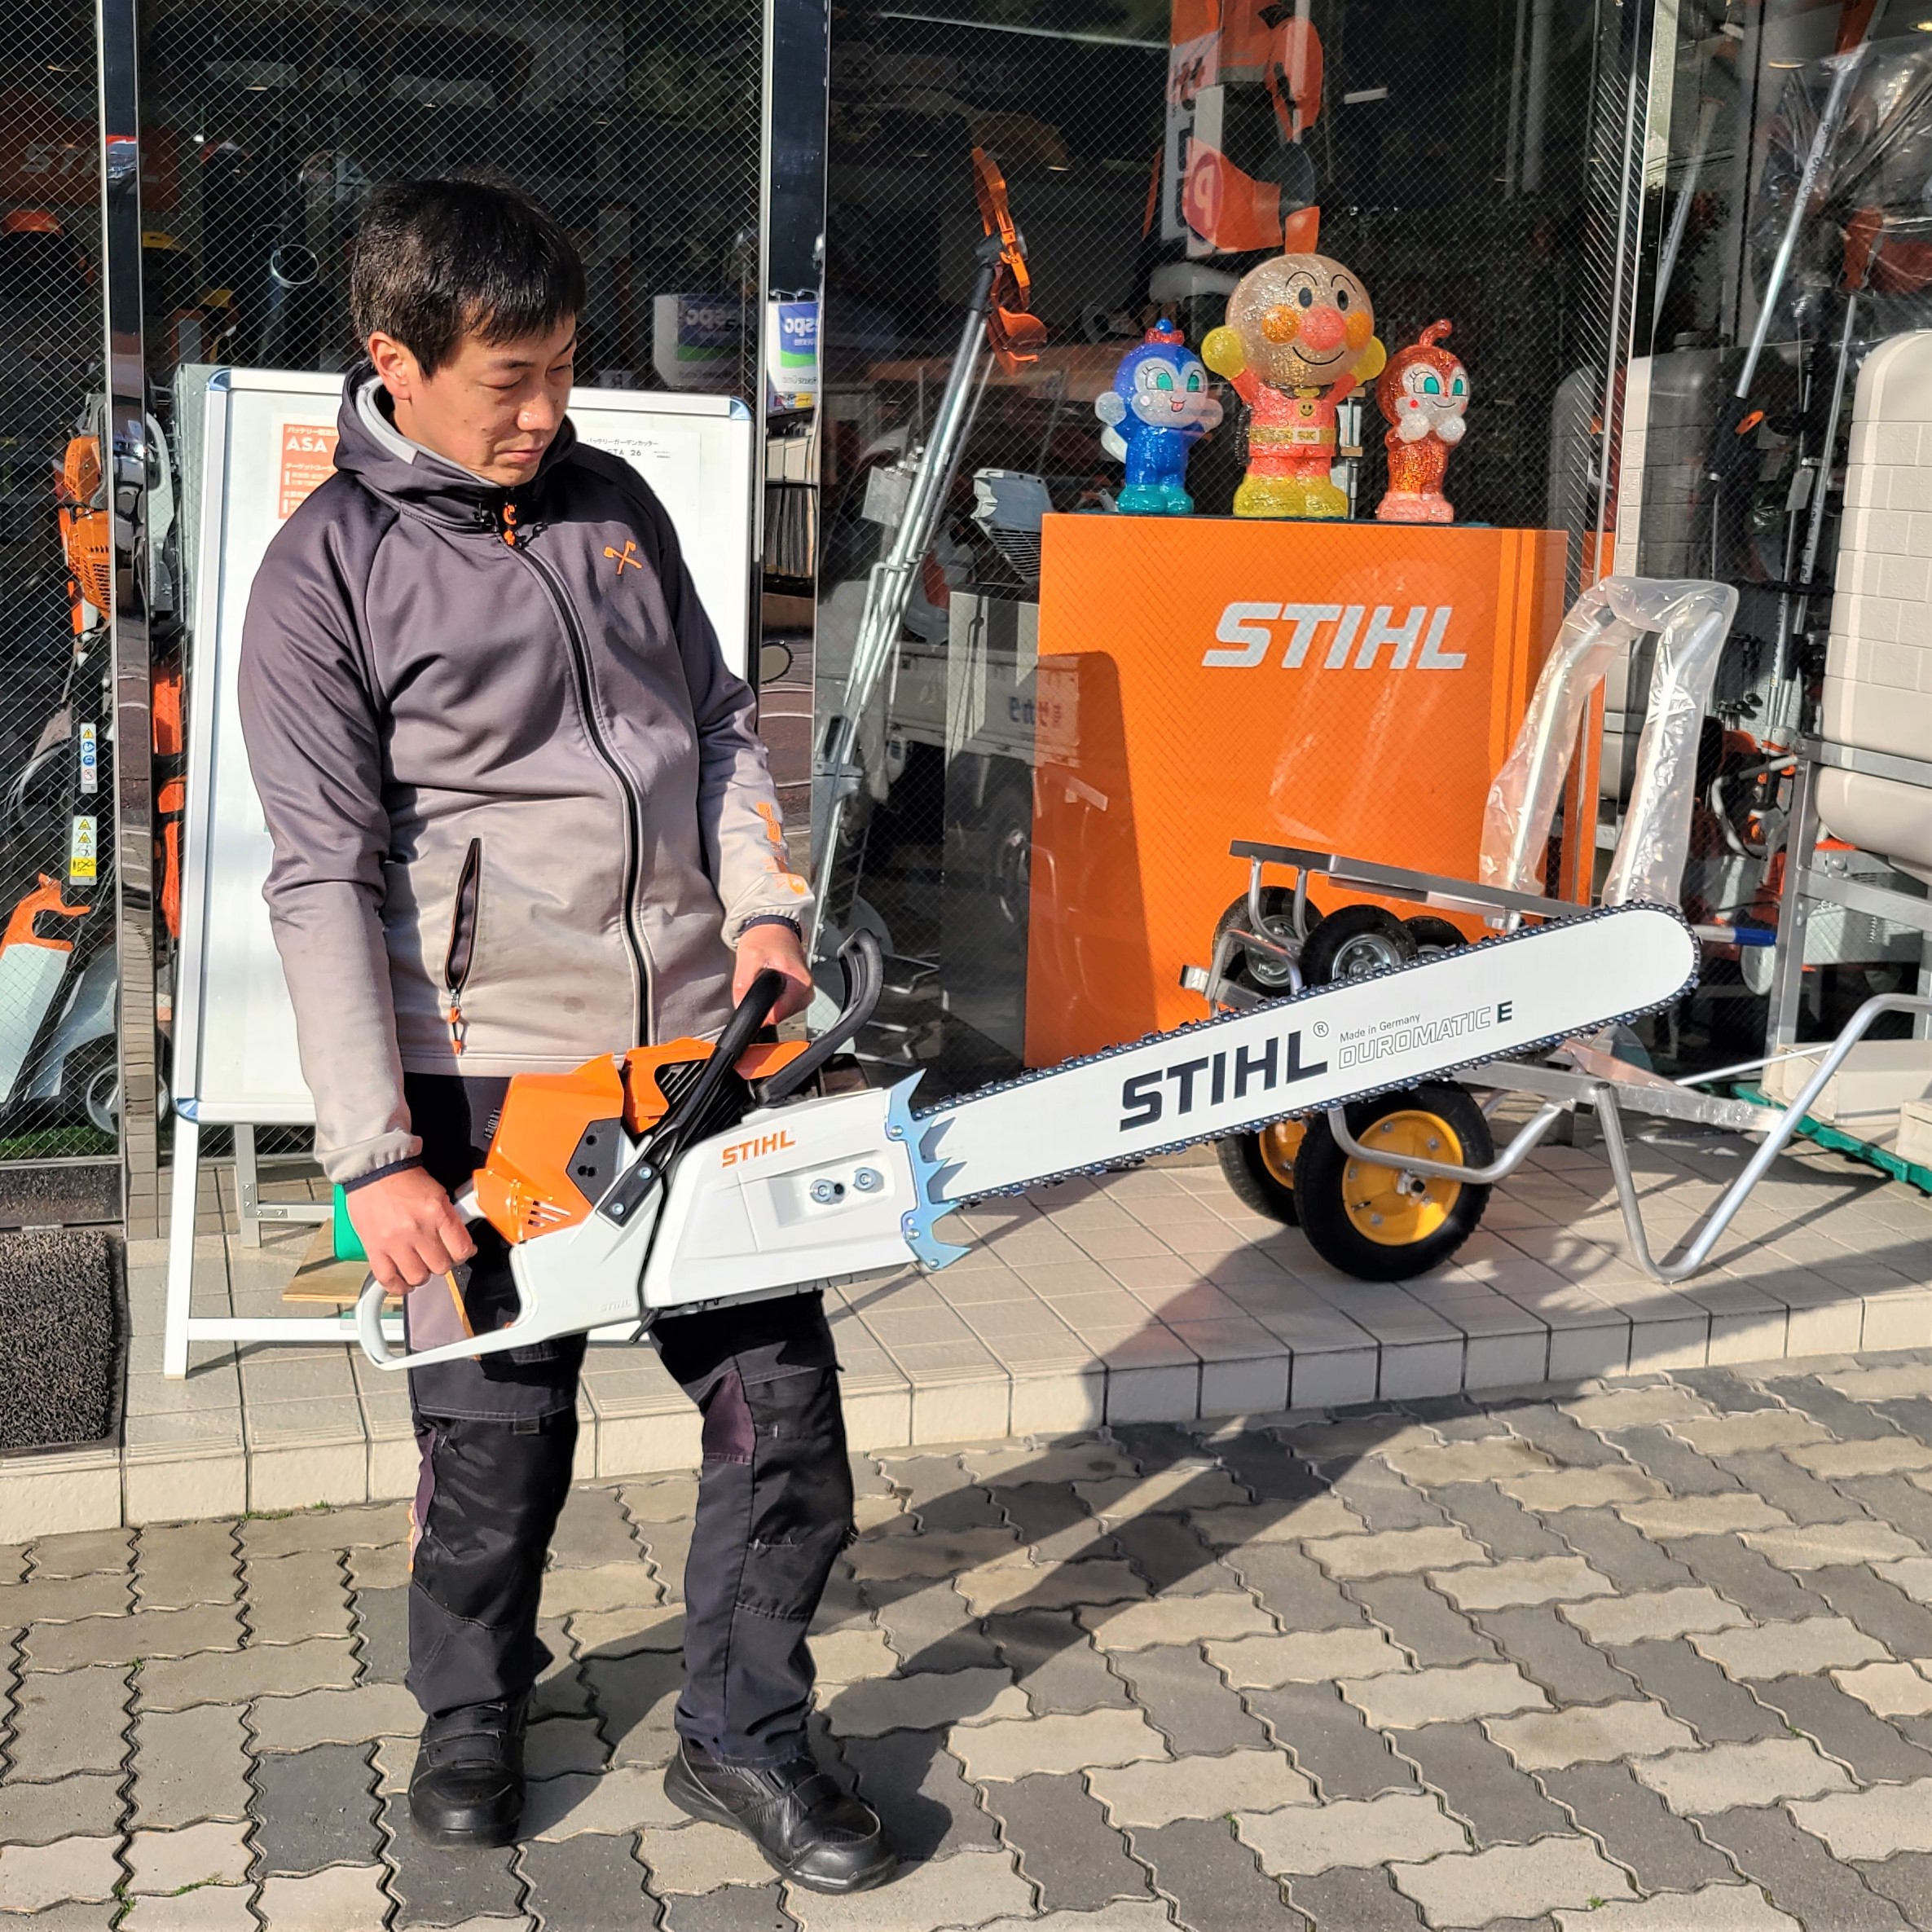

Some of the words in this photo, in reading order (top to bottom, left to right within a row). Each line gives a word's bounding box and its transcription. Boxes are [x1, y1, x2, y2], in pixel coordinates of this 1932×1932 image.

[286, 436, 328, 453] ASA
[1202, 601, 1468, 671] STIHL
[1339, 1006, 1490, 1069] DUROMATIC
[1497, 1001, 1512, 1023] E
[1340, 1028, 1365, 1042] Made
[1368, 1025, 1376, 1034] in
[1380, 1014, 1420, 1031] Germany
[1120, 1030, 1329, 1132] STIHL
[721, 1129, 796, 1168] STIHL
